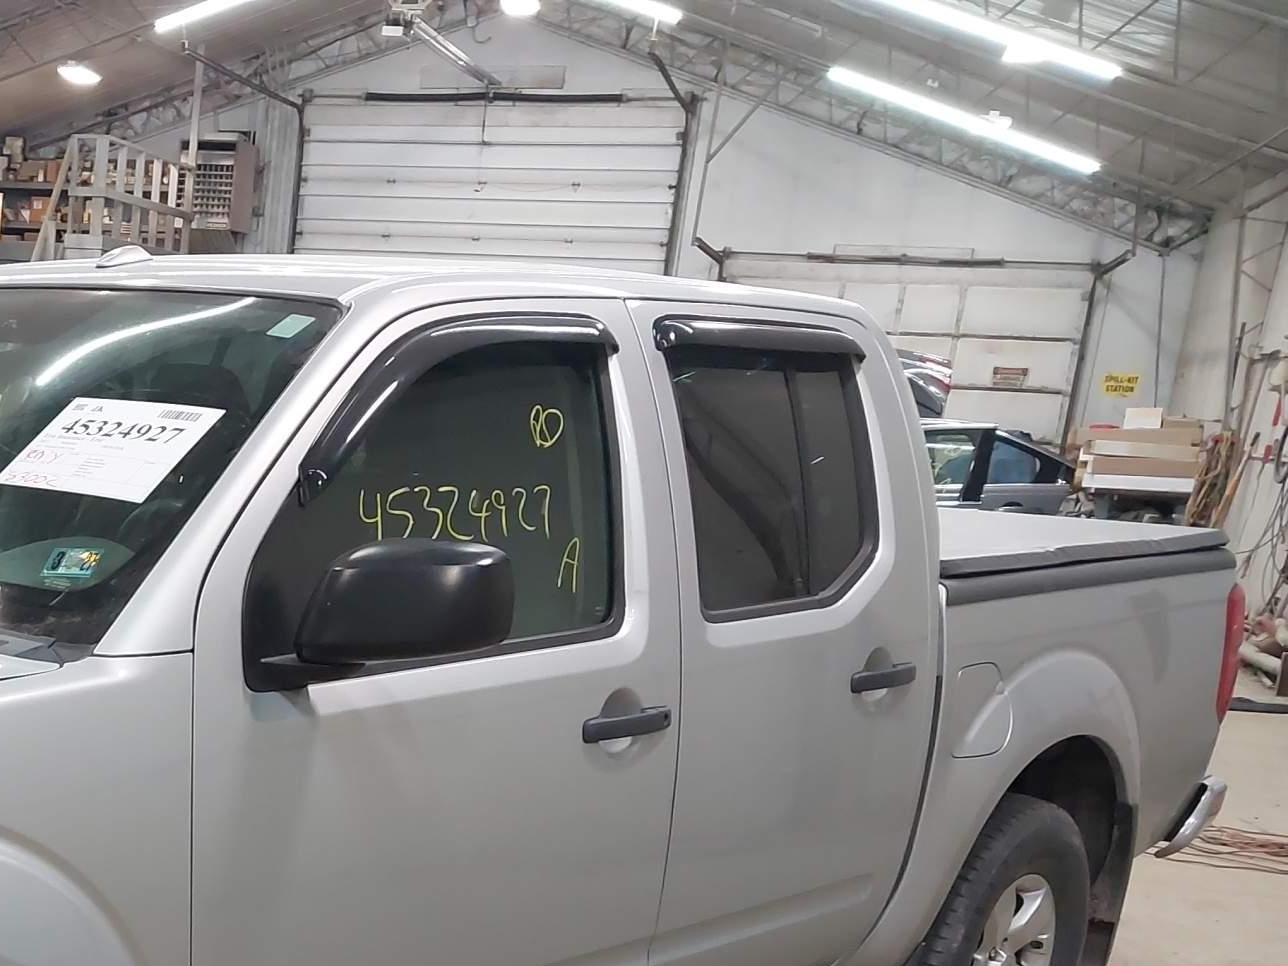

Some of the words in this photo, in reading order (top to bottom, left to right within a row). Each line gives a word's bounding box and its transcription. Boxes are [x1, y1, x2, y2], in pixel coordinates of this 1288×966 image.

[1105, 384, 1134, 392] STATION
[62, 418, 186, 444] 45324927
[359, 484, 552, 542] 45324927
[557, 536, 580, 593] A
